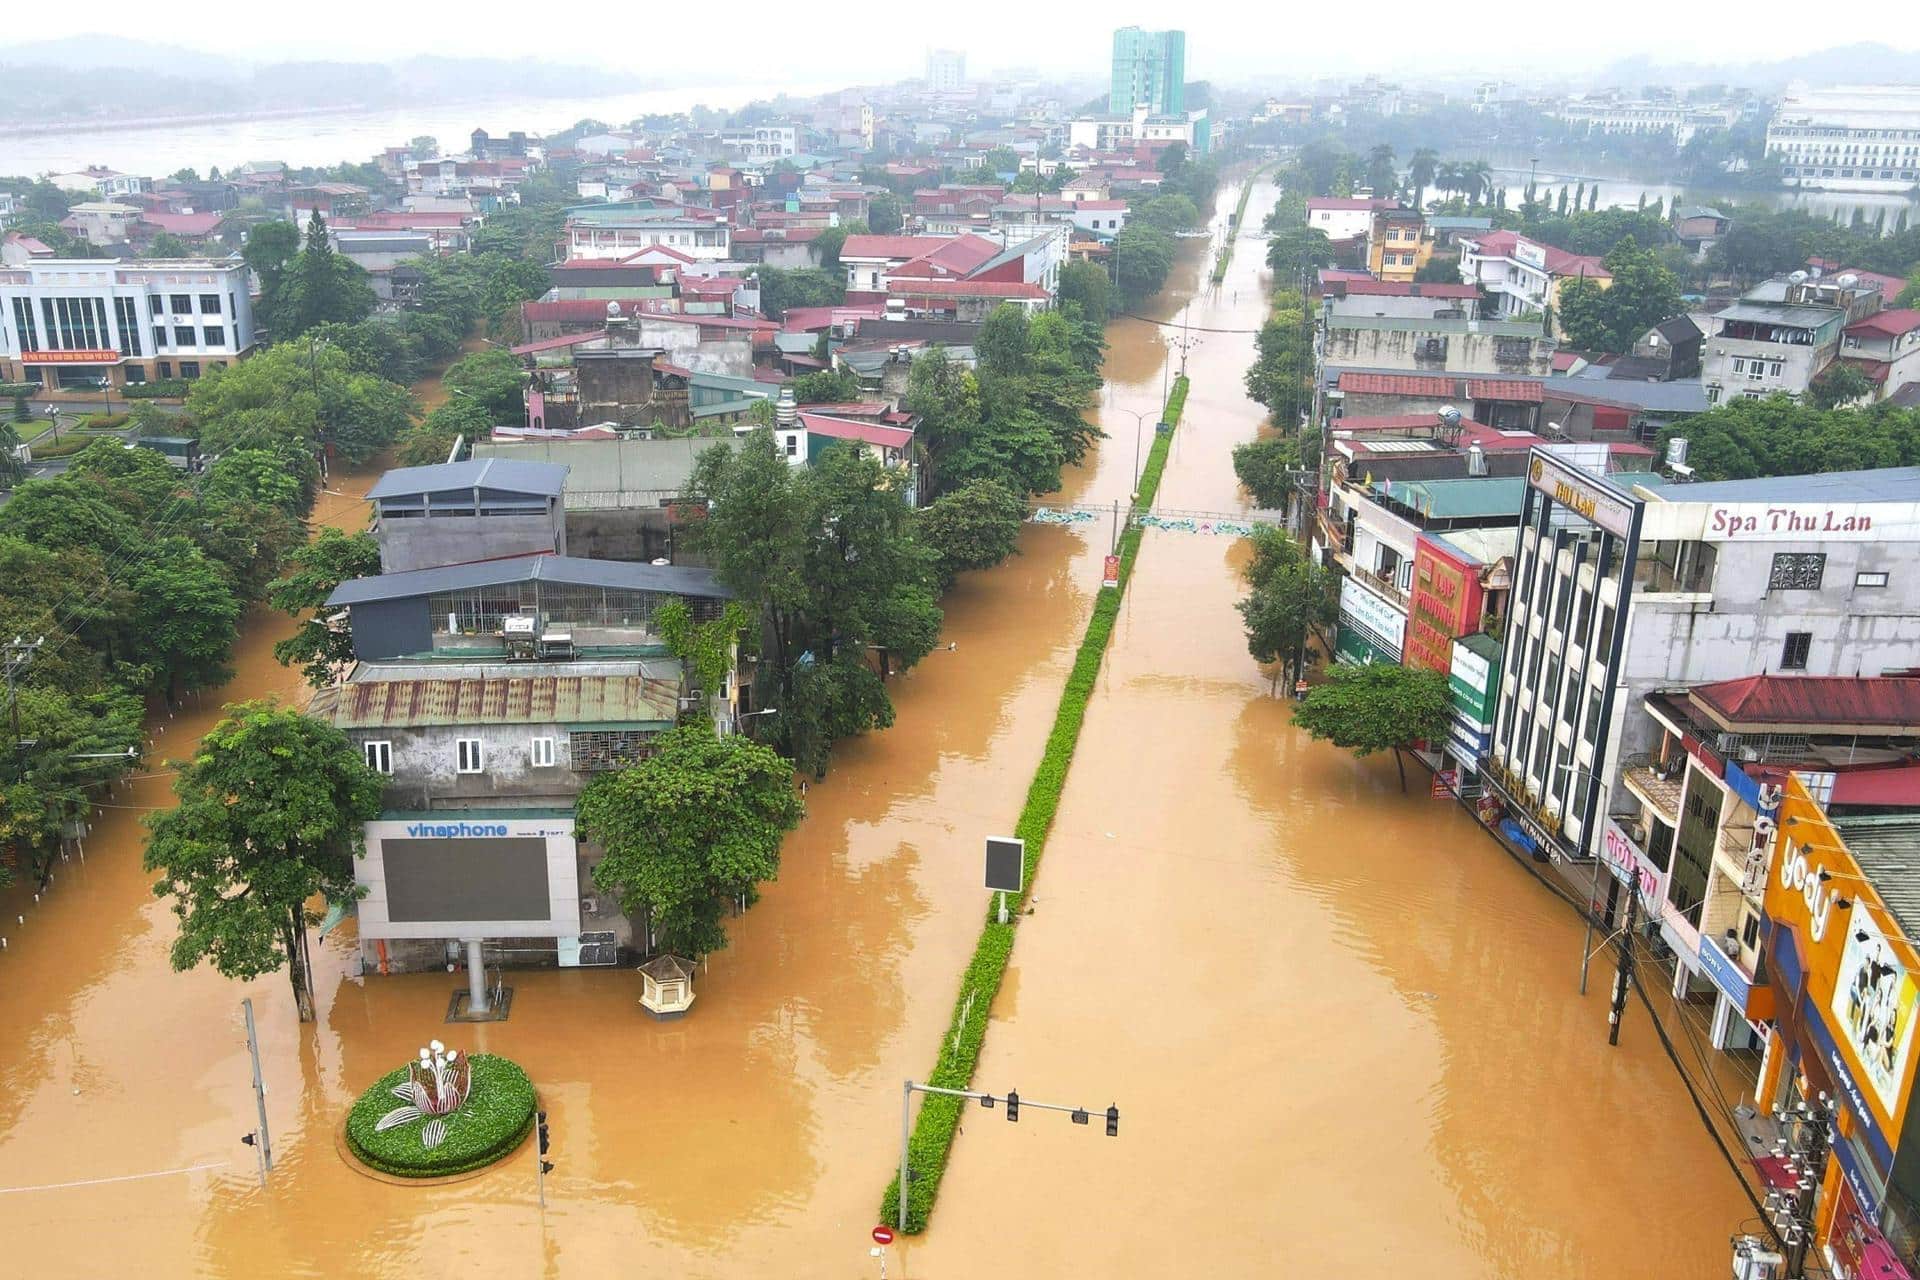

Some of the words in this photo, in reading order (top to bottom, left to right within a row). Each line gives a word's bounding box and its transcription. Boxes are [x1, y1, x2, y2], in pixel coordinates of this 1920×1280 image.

[1712, 508, 1757, 537] Spa
[1767, 508, 1817, 532] Thu
[1822, 510, 1873, 532] Lan
[407, 822, 508, 838] vinaphone
[1701, 947, 1722, 972] SONY
